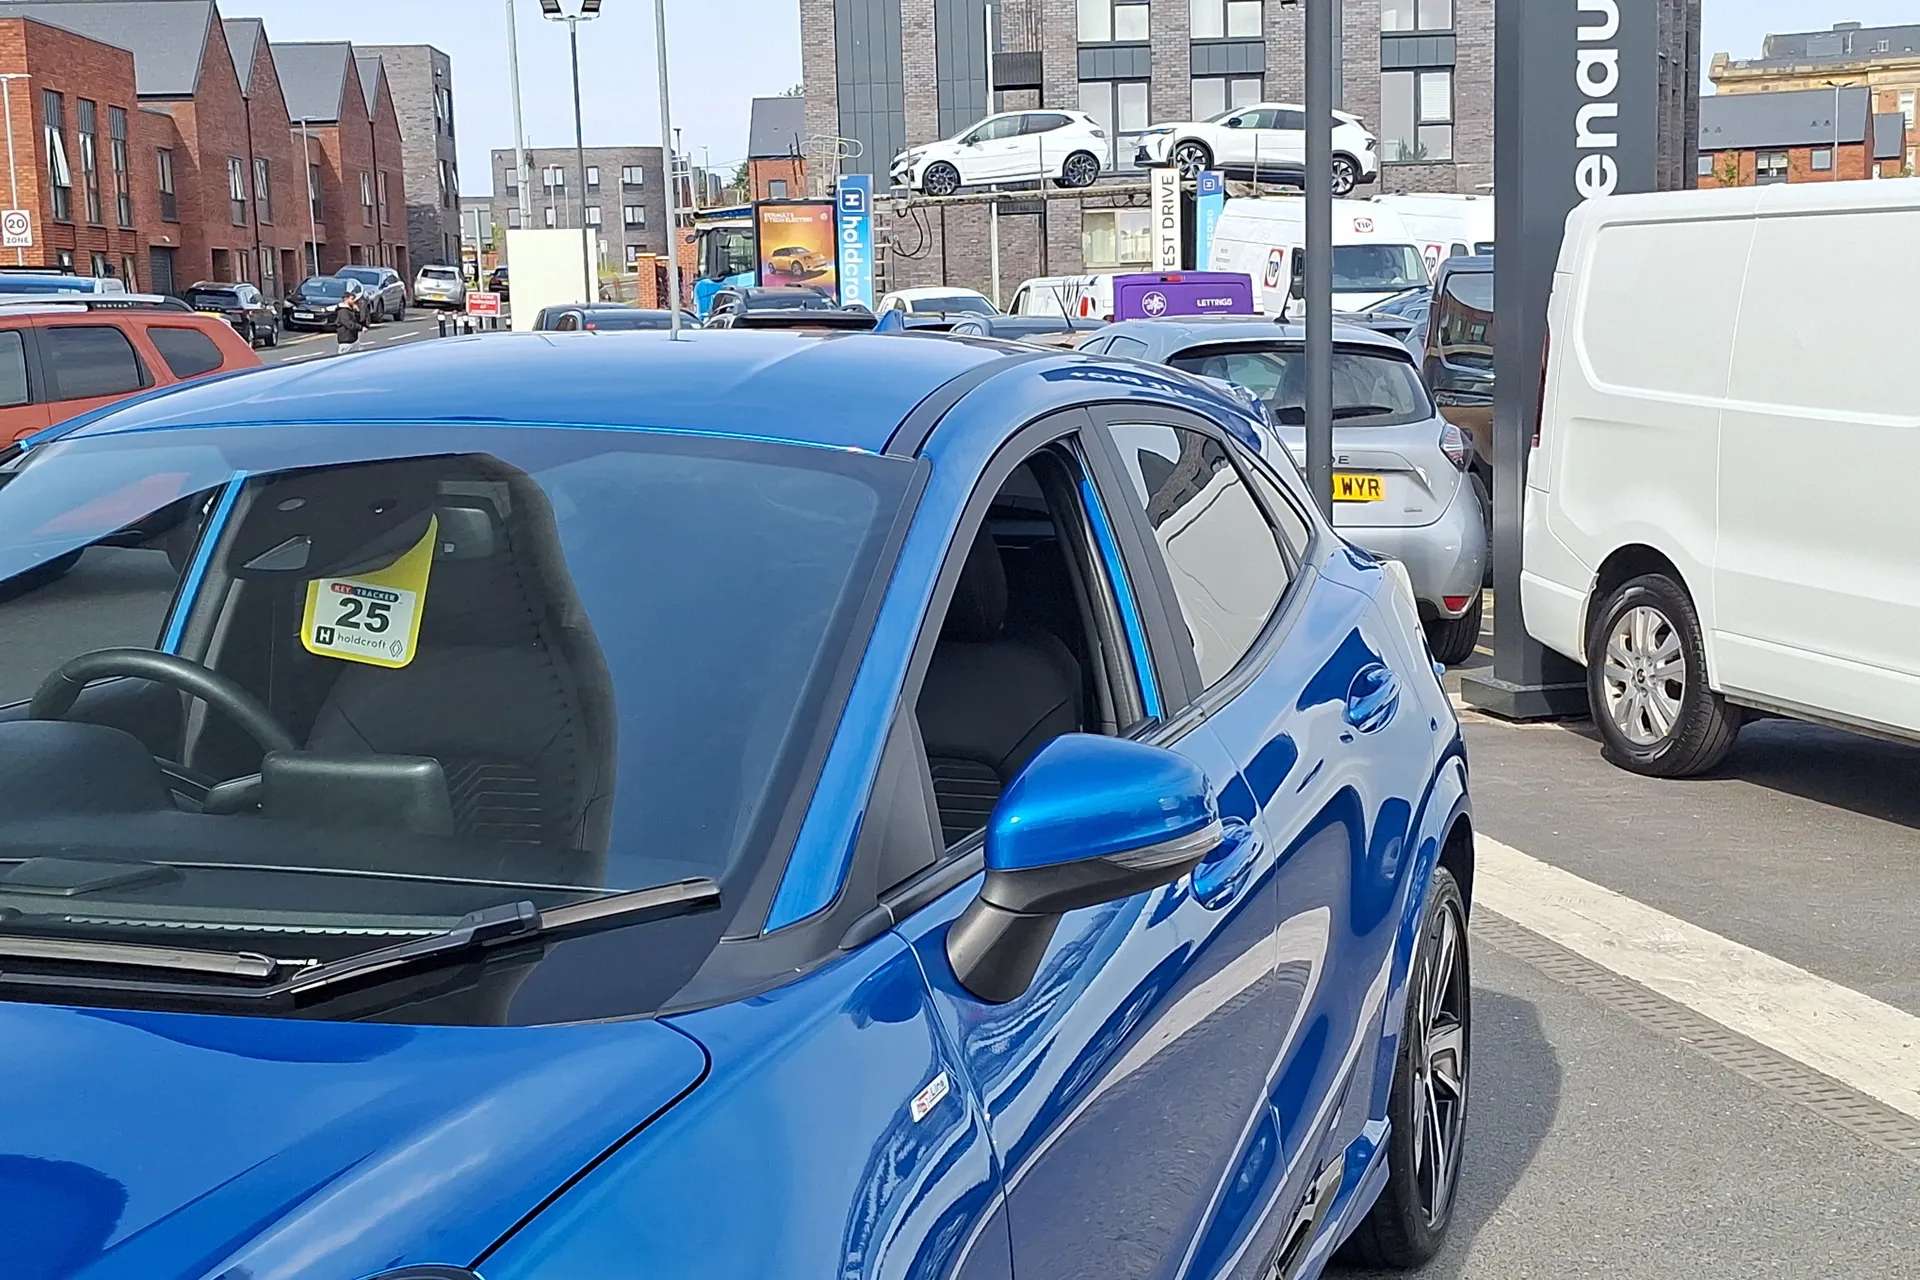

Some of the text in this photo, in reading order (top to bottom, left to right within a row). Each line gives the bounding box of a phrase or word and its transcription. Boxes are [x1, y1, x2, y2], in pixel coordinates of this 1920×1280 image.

[8, 219, 25, 229] 20
[1161, 175, 1175, 272] EST DRIVE
[1356, 221, 1371, 229] TIP
[1268, 260, 1280, 278] TIP
[1424, 256, 1436, 273] TIP
[1341, 477, 1380, 497] WYR
[334, 585, 396, 601] KEY TRACKER
[335, 597, 391, 633] 25
[337, 633, 387, 648] holdcroft
